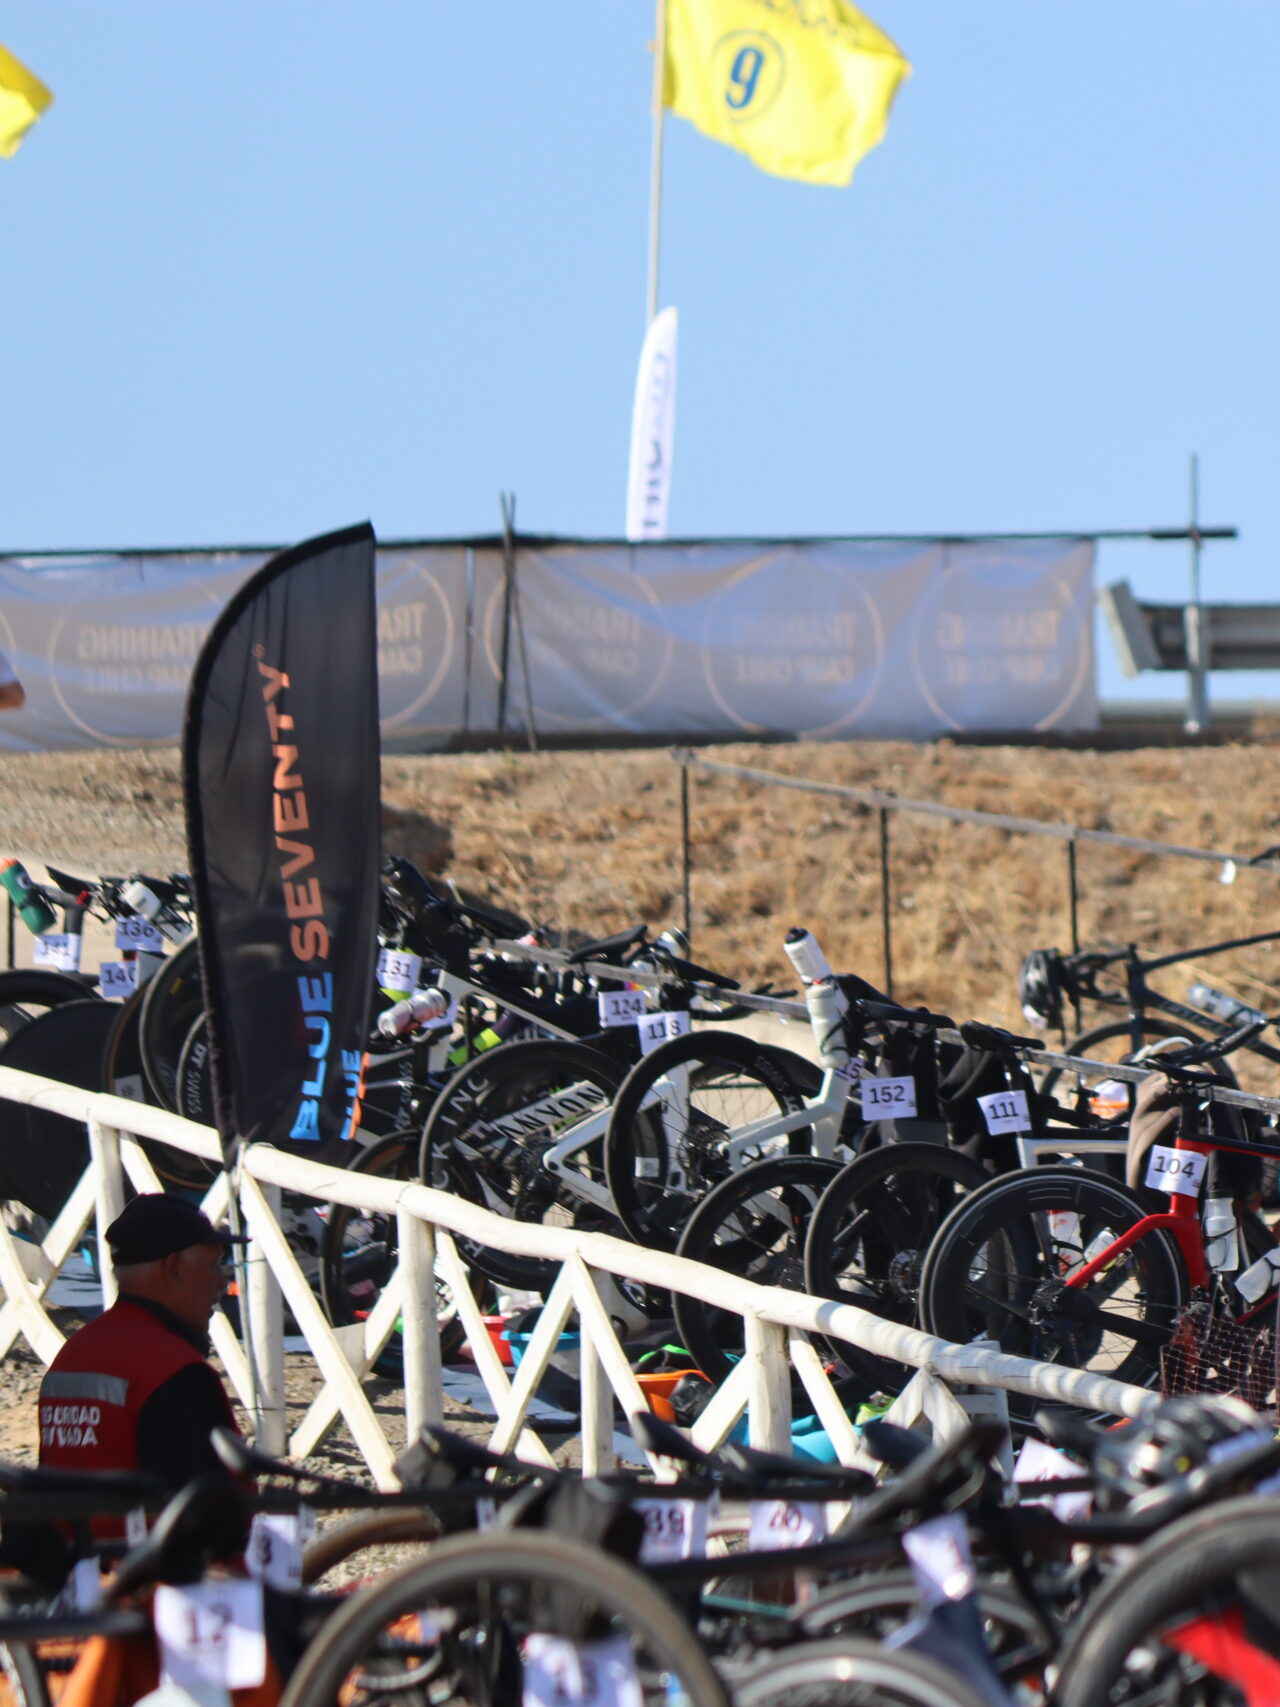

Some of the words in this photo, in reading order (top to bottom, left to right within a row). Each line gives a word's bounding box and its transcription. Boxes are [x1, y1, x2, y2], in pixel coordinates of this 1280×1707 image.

[257, 662, 331, 962] SEVENTY
[119, 920, 156, 939] 136
[379, 957, 412, 979] 131
[647, 1019, 681, 1040] 118
[289, 971, 333, 1141] BLUE
[868, 1084, 905, 1104] 152
[496, 1085, 607, 1142] ANYON
[988, 1101, 1019, 1121] 111
[1153, 1154, 1195, 1178] 104
